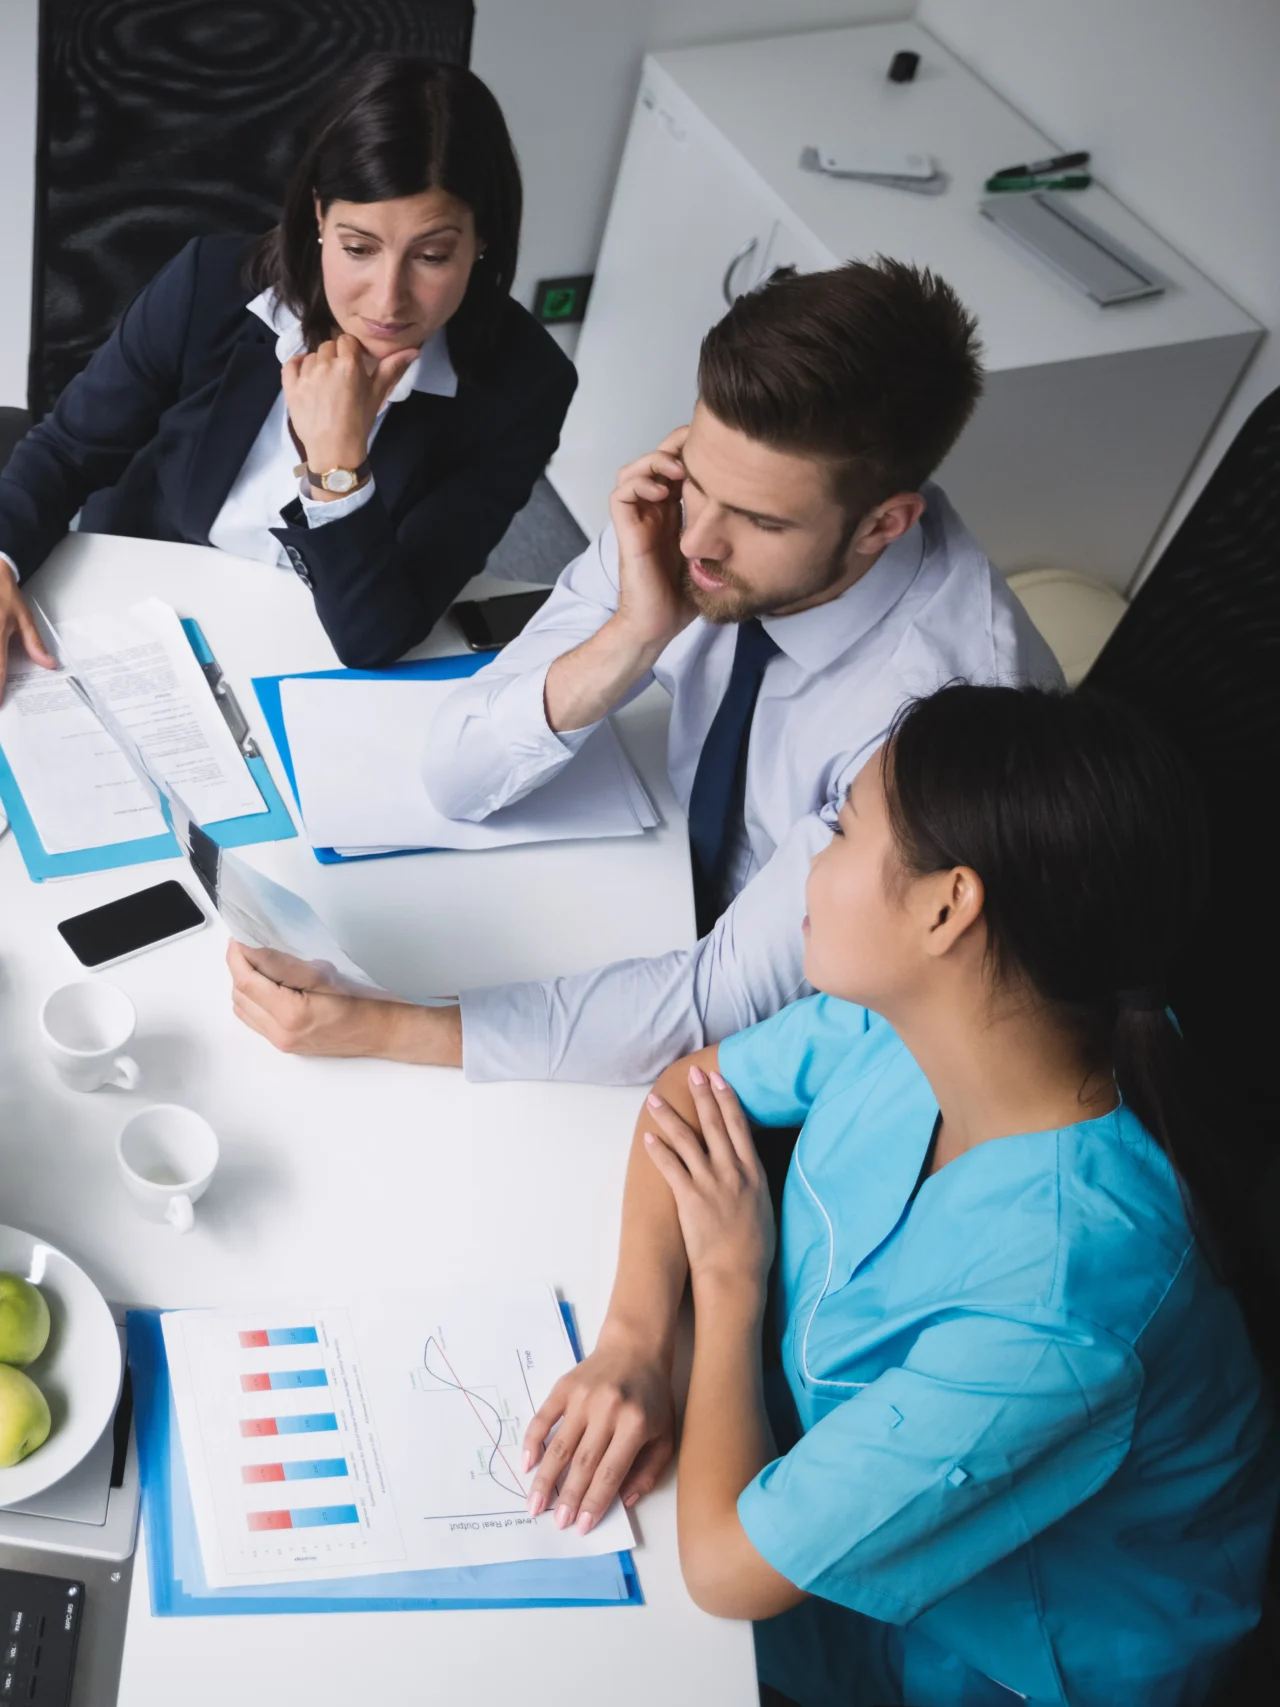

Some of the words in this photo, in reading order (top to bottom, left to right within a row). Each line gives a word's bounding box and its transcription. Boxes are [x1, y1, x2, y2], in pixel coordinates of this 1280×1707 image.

[524, 1350, 534, 1369] Time
[448, 1519, 479, 1533] Output
[481, 1518, 502, 1529] Real
[503, 1518, 512, 1527] of
[514, 1514, 538, 1526] Level
